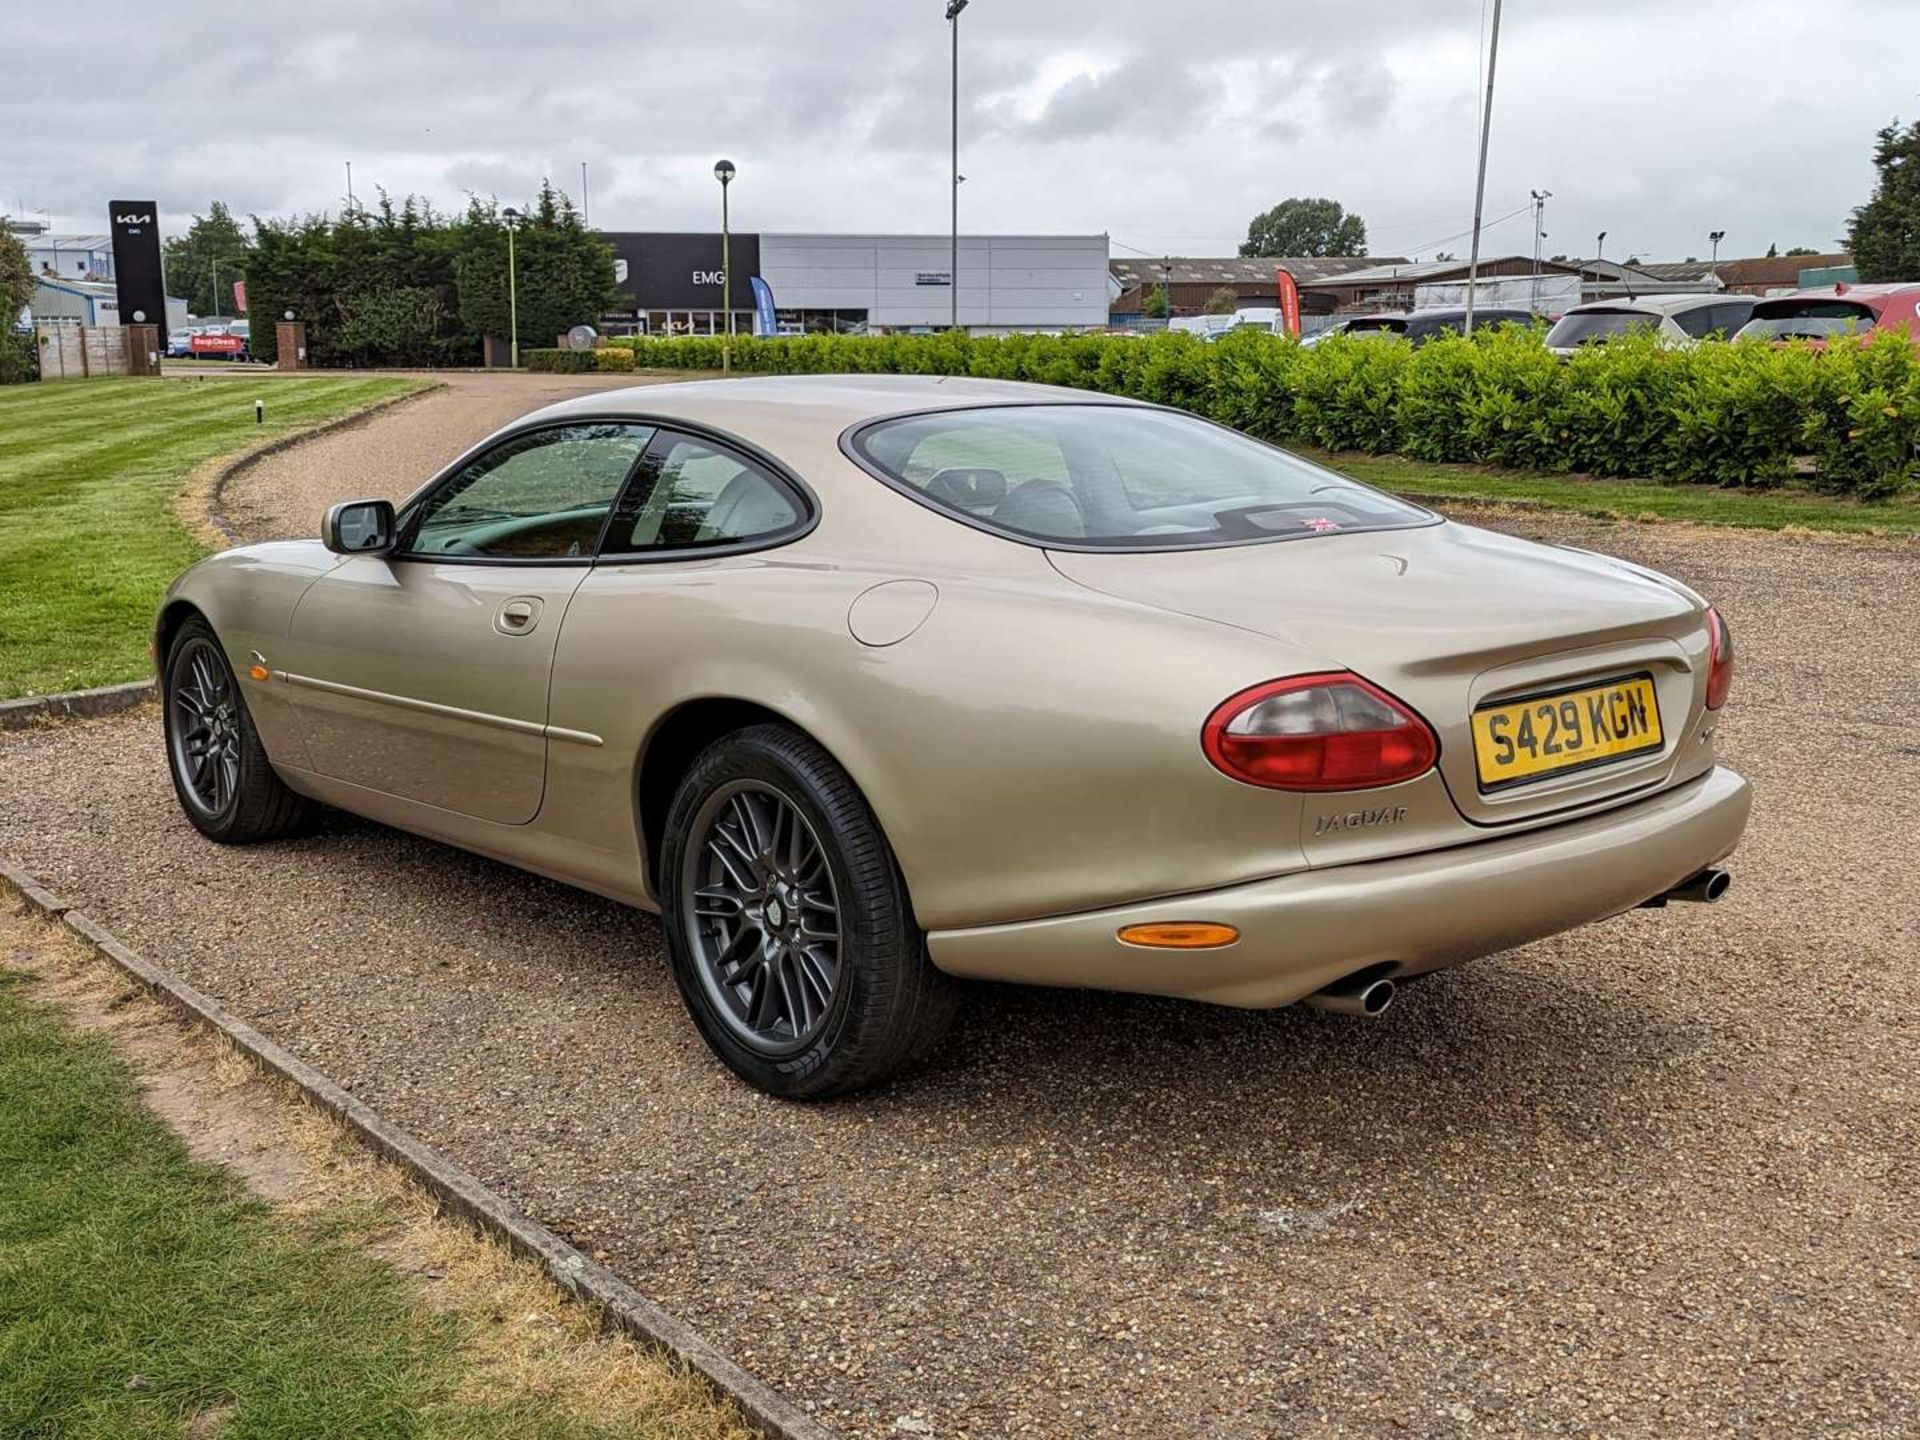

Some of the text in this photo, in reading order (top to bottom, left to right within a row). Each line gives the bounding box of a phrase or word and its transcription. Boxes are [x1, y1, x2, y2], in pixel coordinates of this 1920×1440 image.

[692, 271, 726, 285] EMG
[1488, 687, 1649, 766] S429 KGN
[1313, 806, 1409, 837] JAGUAR
